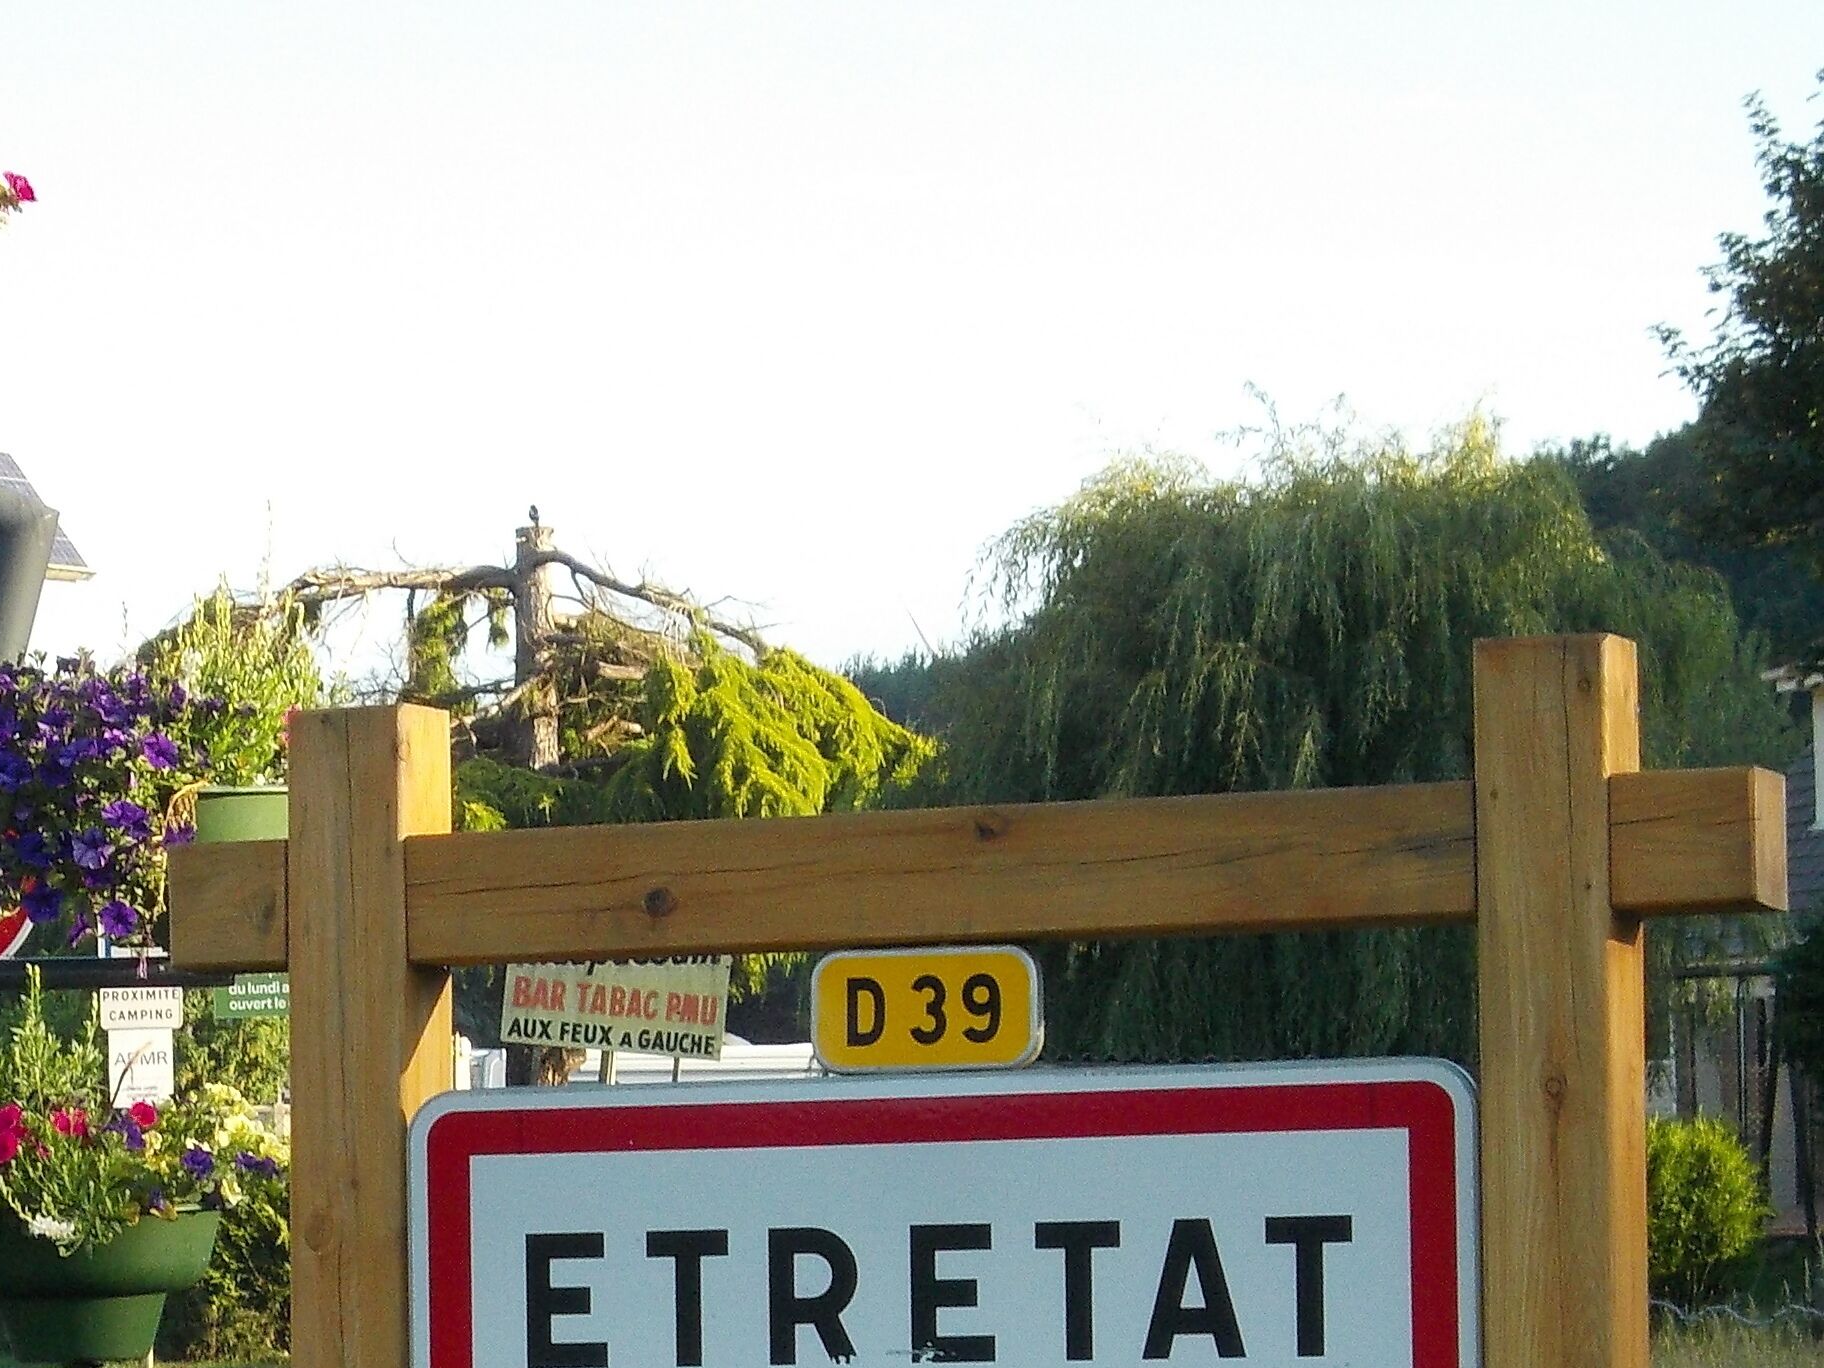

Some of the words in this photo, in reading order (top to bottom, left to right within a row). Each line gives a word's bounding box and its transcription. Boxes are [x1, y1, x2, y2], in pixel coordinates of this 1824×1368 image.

[102, 988, 180, 1003] PROXIMITE
[228, 982, 246, 996] du
[247, 980, 281, 995] lundi
[229, 997, 273, 1011] ouvert
[274, 995, 287, 1010] le
[511, 975, 567, 1012] BAR
[576, 981, 660, 1020] TABAC
[109, 1008, 174, 1022] CAMPING
[846, 977, 886, 1047] D
[909, 973, 1002, 1045] 39
[507, 1017, 553, 1041] AUX
[559, 1020, 614, 1047] FEUX
[619, 1031, 633, 1049] A
[638, 1028, 716, 1056] GAUCHE
